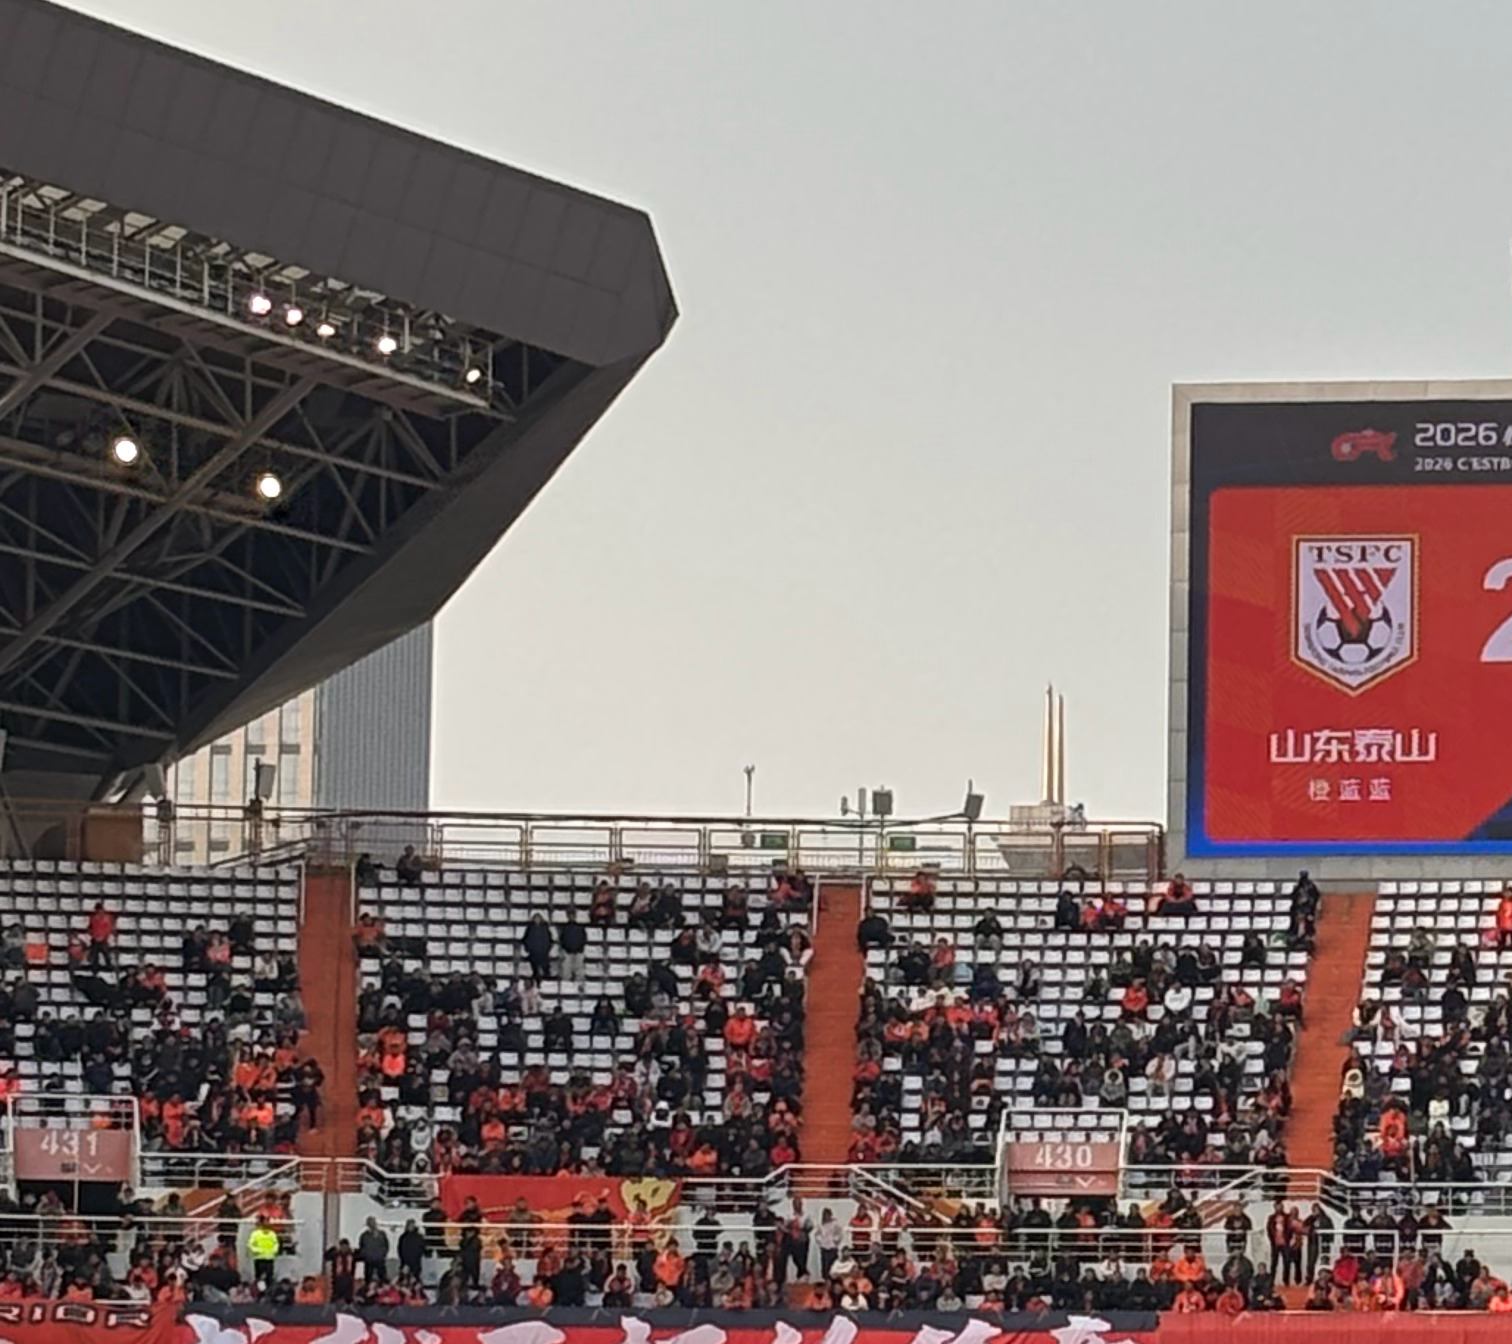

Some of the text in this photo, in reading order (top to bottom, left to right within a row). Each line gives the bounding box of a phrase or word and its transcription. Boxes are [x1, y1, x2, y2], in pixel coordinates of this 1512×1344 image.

[1414, 457, 1453, 472] 2026
[1309, 544, 1402, 564] TSFC
[1269, 728, 1437, 763] 山东泰山
[40, 1129, 98, 1157] 431
[1035, 1142, 1093, 1170] 430
